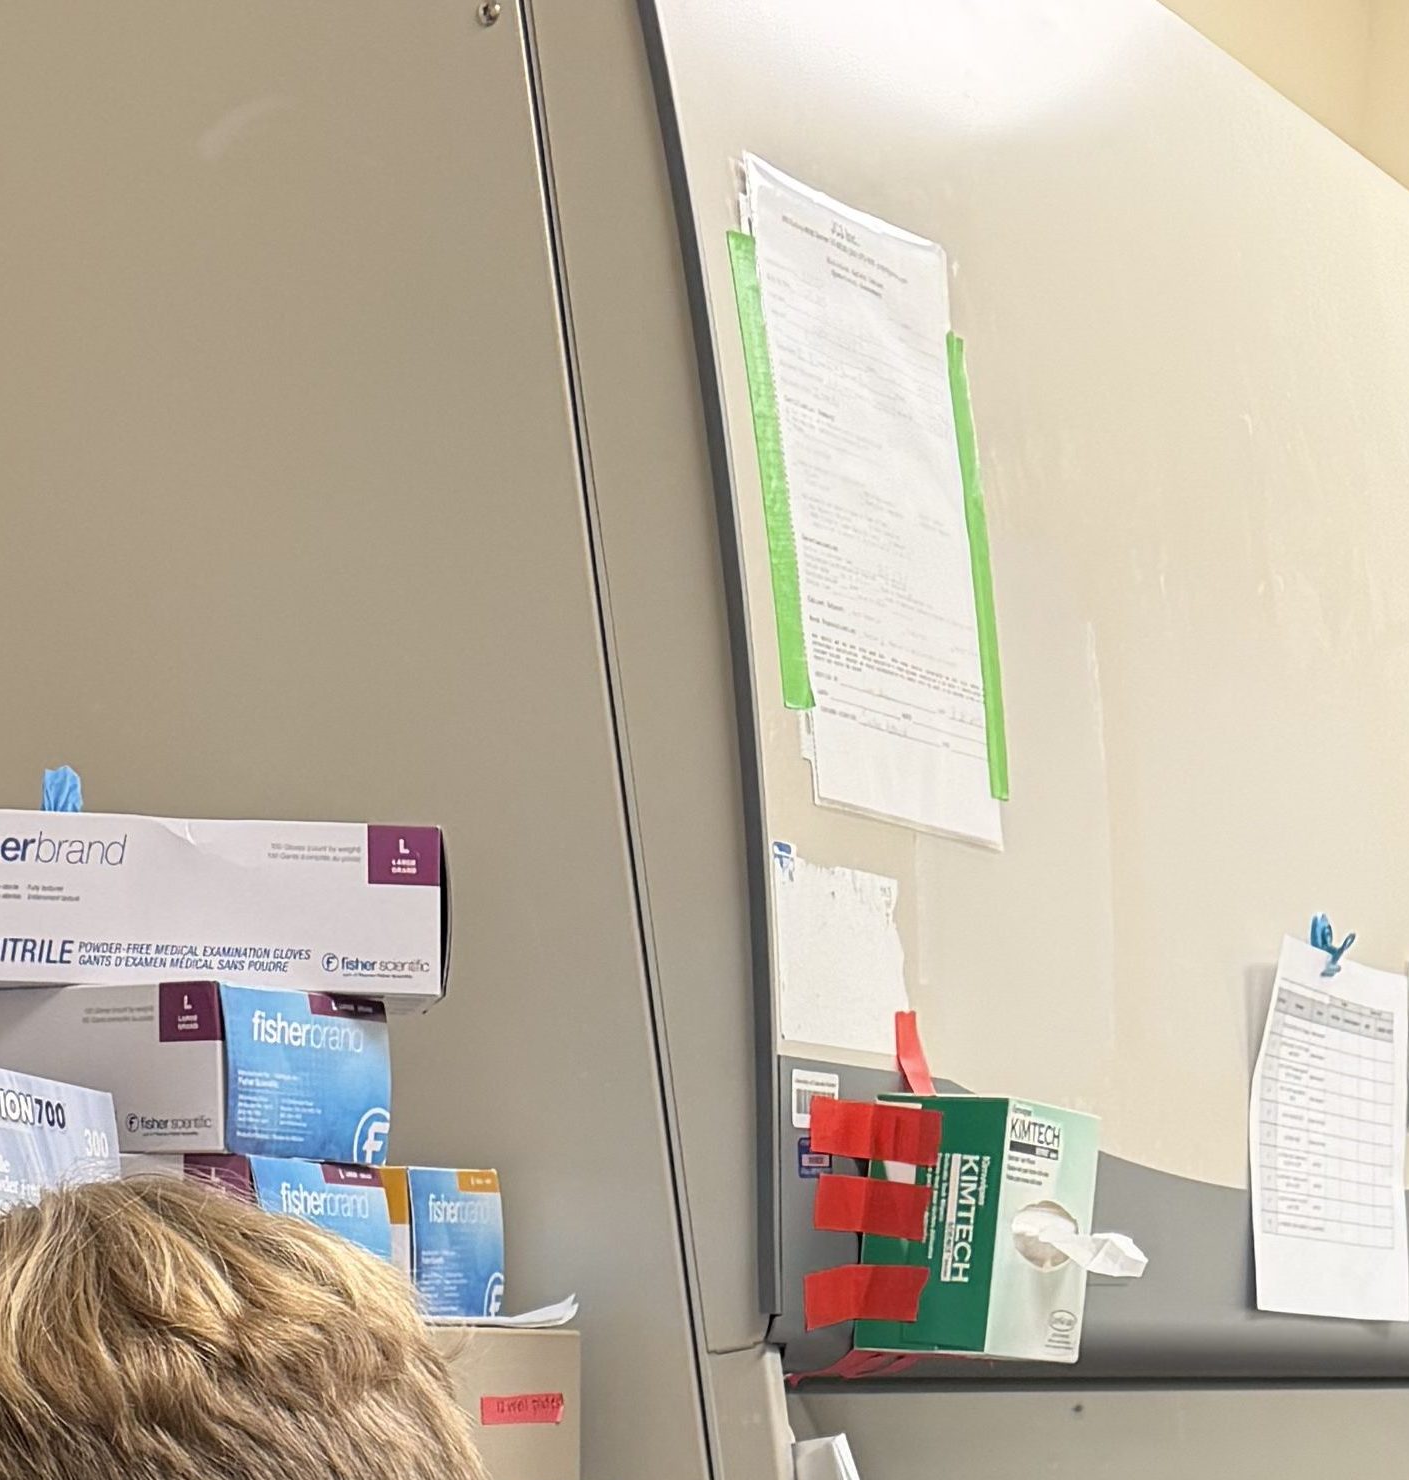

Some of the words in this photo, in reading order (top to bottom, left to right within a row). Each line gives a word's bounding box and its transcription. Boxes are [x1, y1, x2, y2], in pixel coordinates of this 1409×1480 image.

[398, 838, 410, 854] L
[78, 941, 151, 954] POWDER-FREE
[155, 944, 200, 958] MEDICAL
[203, 946, 270, 959] EXAMINATION
[273, 949, 311, 961] GLOVES
[78, 954, 111, 968] GANTS
[114, 955, 166, 969] D'EXAMEN
[217, 959, 245, 971] SANS
[248, 961, 289, 973] POUDRE
[341, 957, 378, 971] fisher
[379, 959, 430, 973] scientific
[183, 995, 192, 1009] L
[252, 1009, 364, 1053] fisherbrand
[141, 1115, 169, 1130] fisher
[1011, 1118, 1061, 1148] KIMTECH
[84, 1128, 110, 1159] 300
[281, 1182, 369, 1219] fisherbrand
[951, 1154, 980, 1282] KIMTECH
